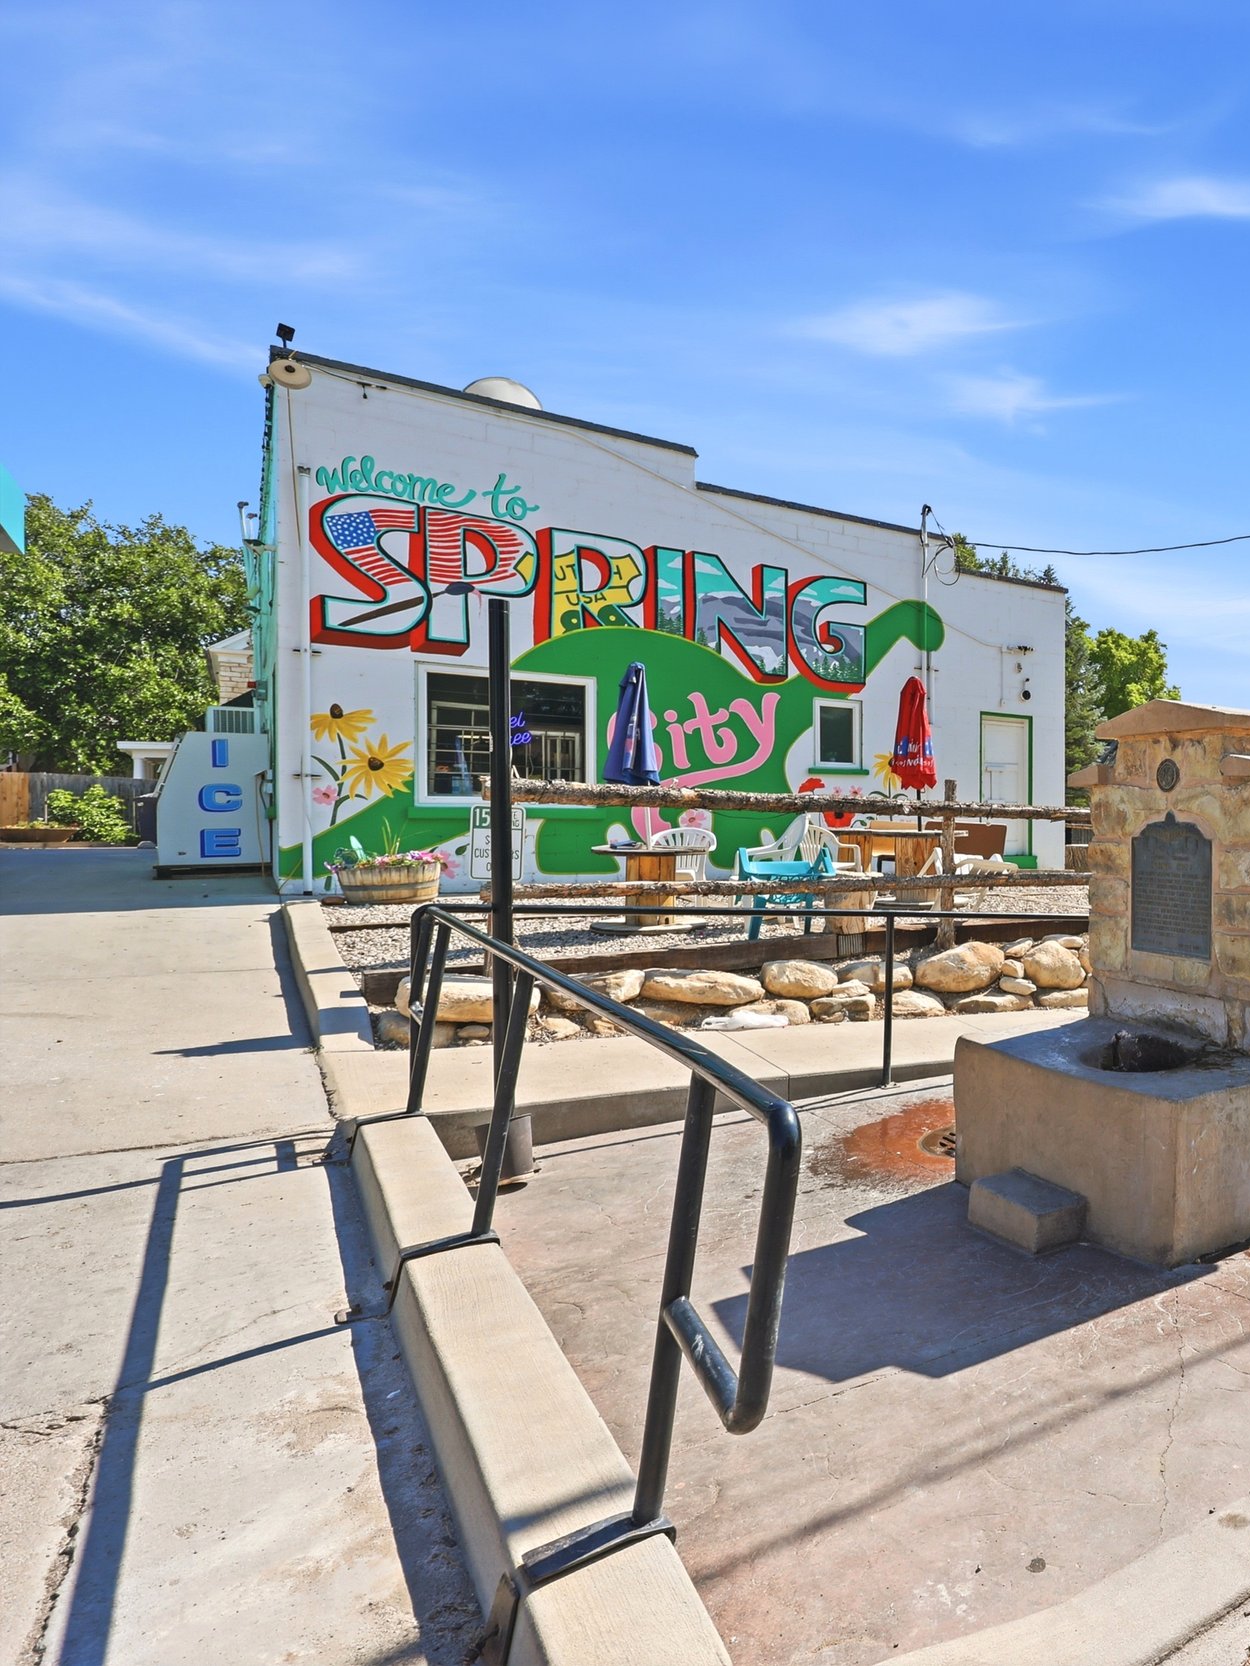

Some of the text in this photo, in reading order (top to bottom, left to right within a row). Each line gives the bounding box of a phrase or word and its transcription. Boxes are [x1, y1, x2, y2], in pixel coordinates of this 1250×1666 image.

[316, 455, 540, 520] Welcome to
[309, 493, 867, 693] SPRING
[554, 564, 622, 581] UTH
[566, 592, 607, 606] USA
[198, 738, 243, 858] ICE
[474, 808, 491, 826] 15
